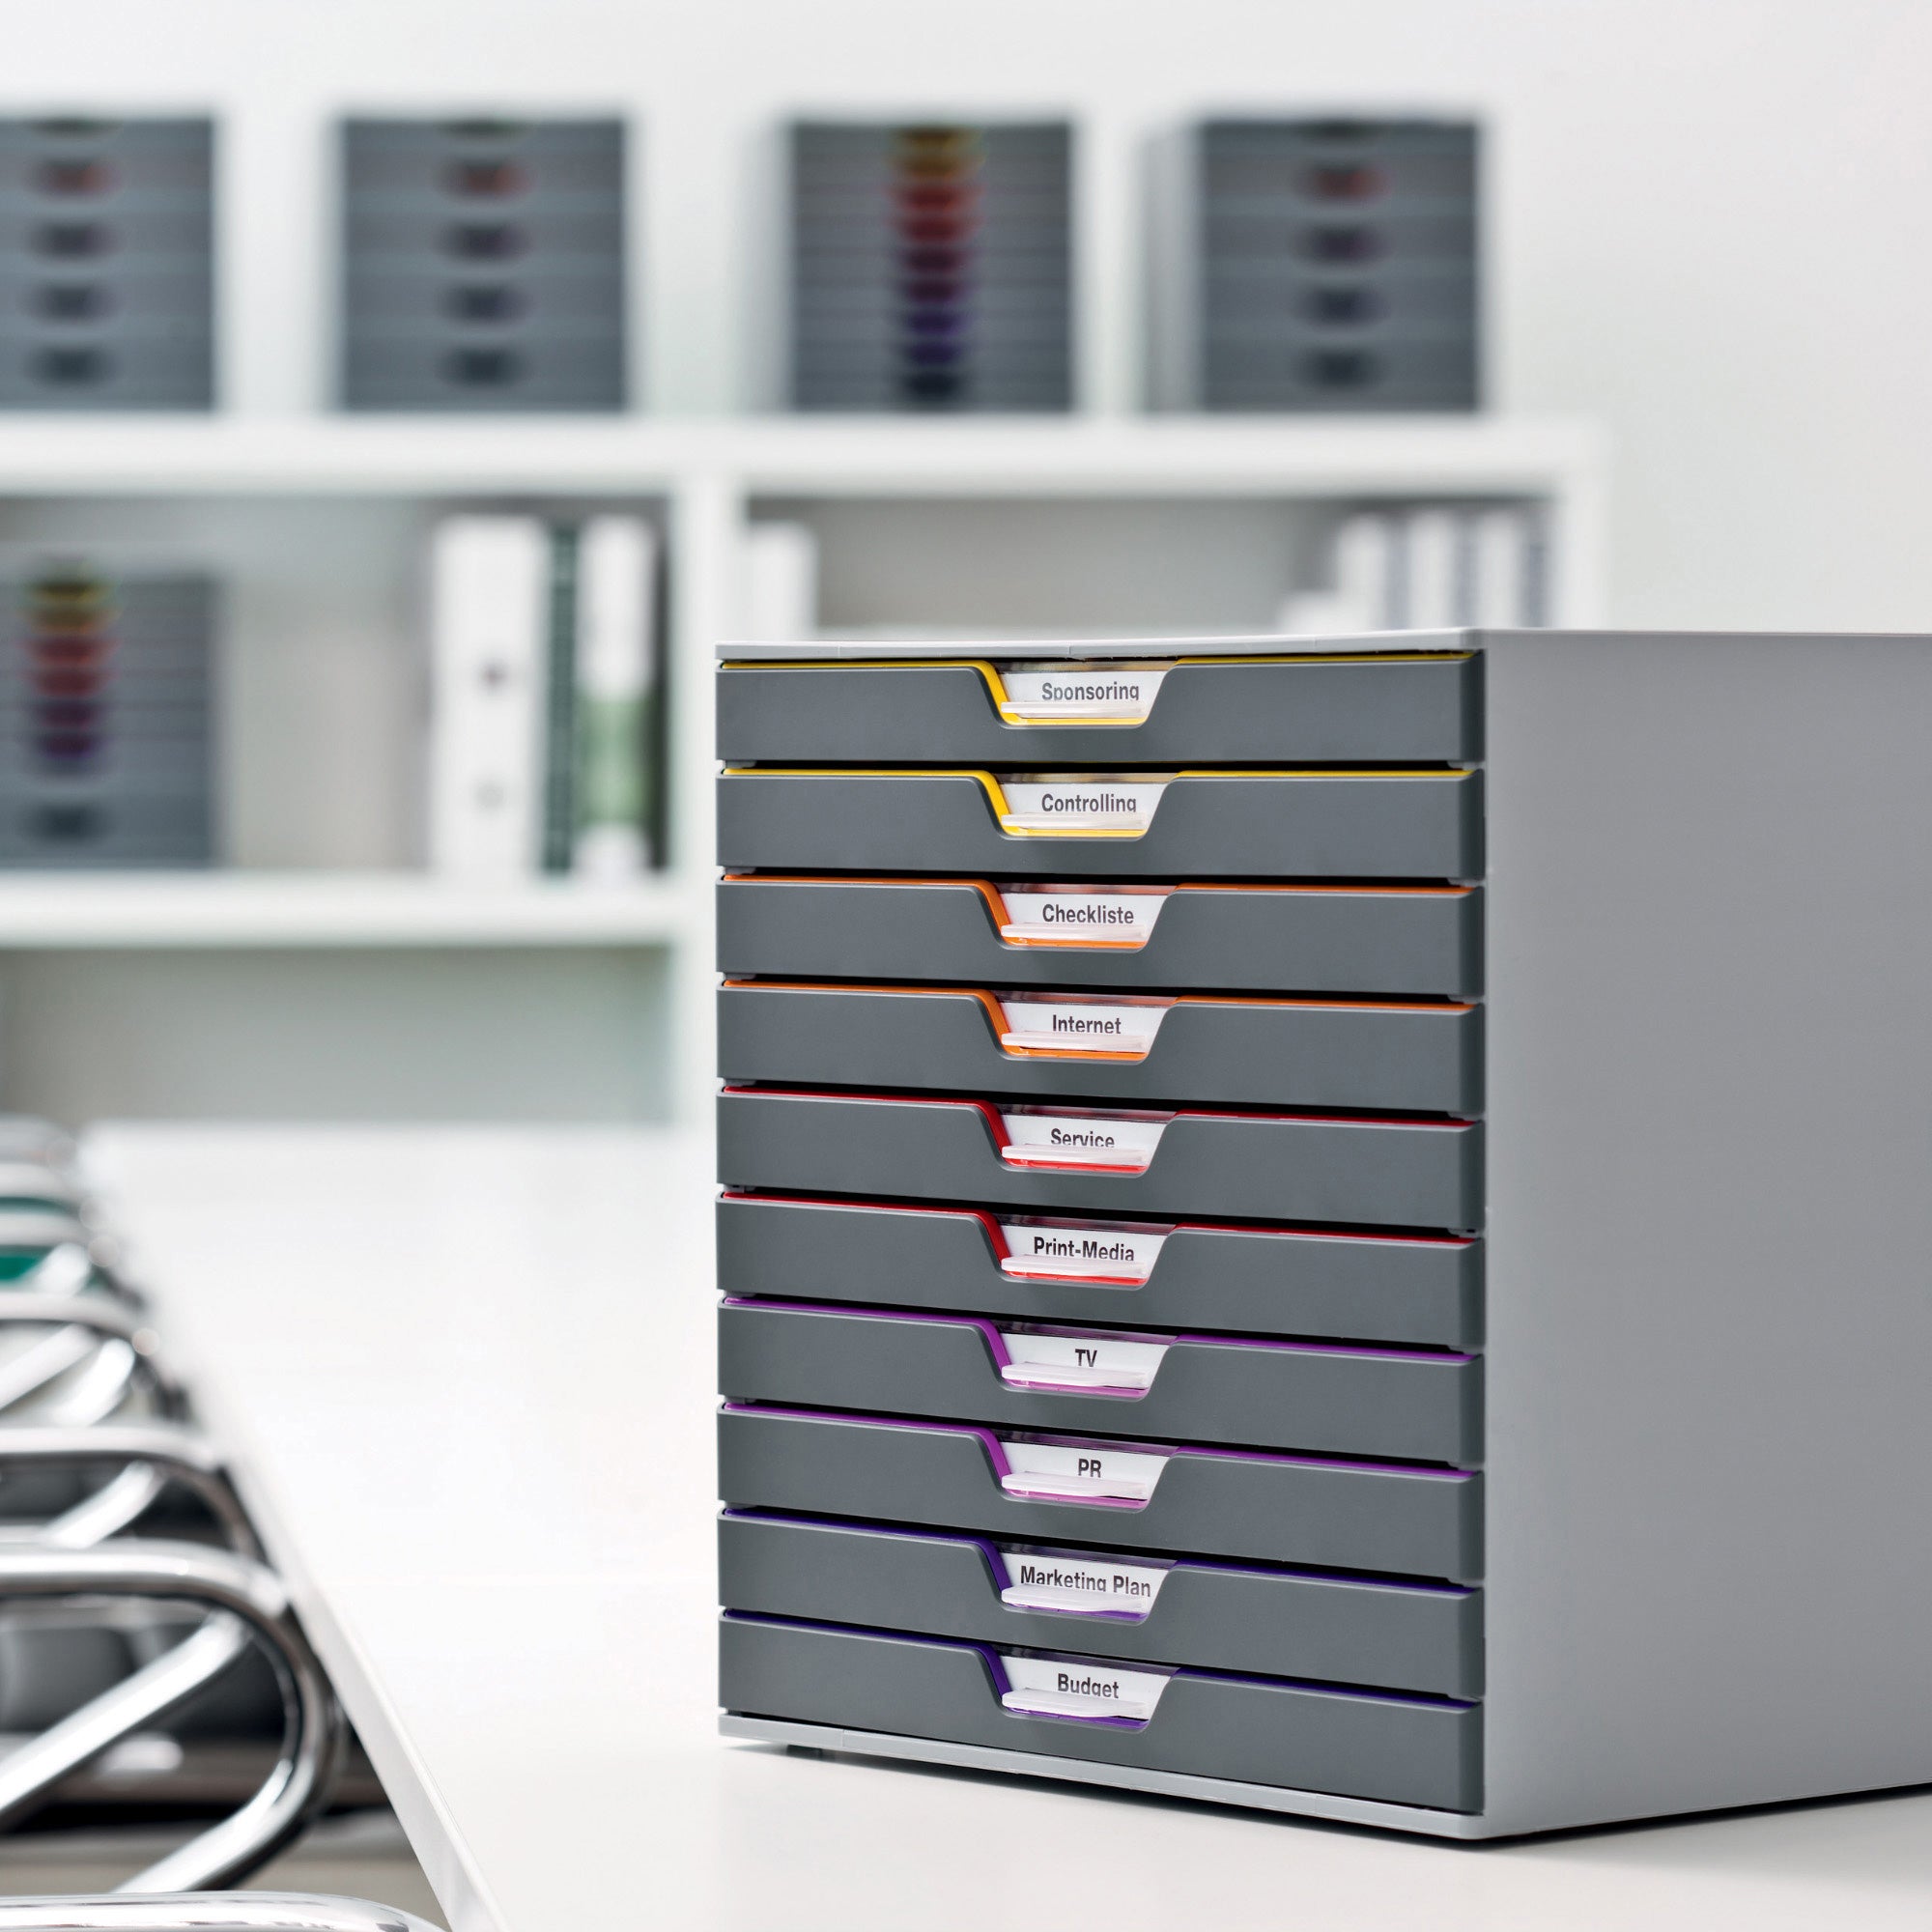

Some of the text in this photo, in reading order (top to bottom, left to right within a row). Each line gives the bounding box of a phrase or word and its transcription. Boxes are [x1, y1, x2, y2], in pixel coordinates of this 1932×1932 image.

[1041, 681, 1140, 701] Sponsoring
[1041, 792, 1137, 813] Controlling
[1041, 903, 1135, 924] Checkliste
[1052, 1014, 1122, 1035] Internet
[1050, 1127, 1116, 1148] Service
[1034, 1236, 1135, 1262] Print-Media
[1074, 1349, 1098, 1368] TV
[1077, 1458, 1102, 1479] PR
[1020, 1565, 1151, 1599] Marketing Plan
[1057, 1673, 1120, 1699] Budget
